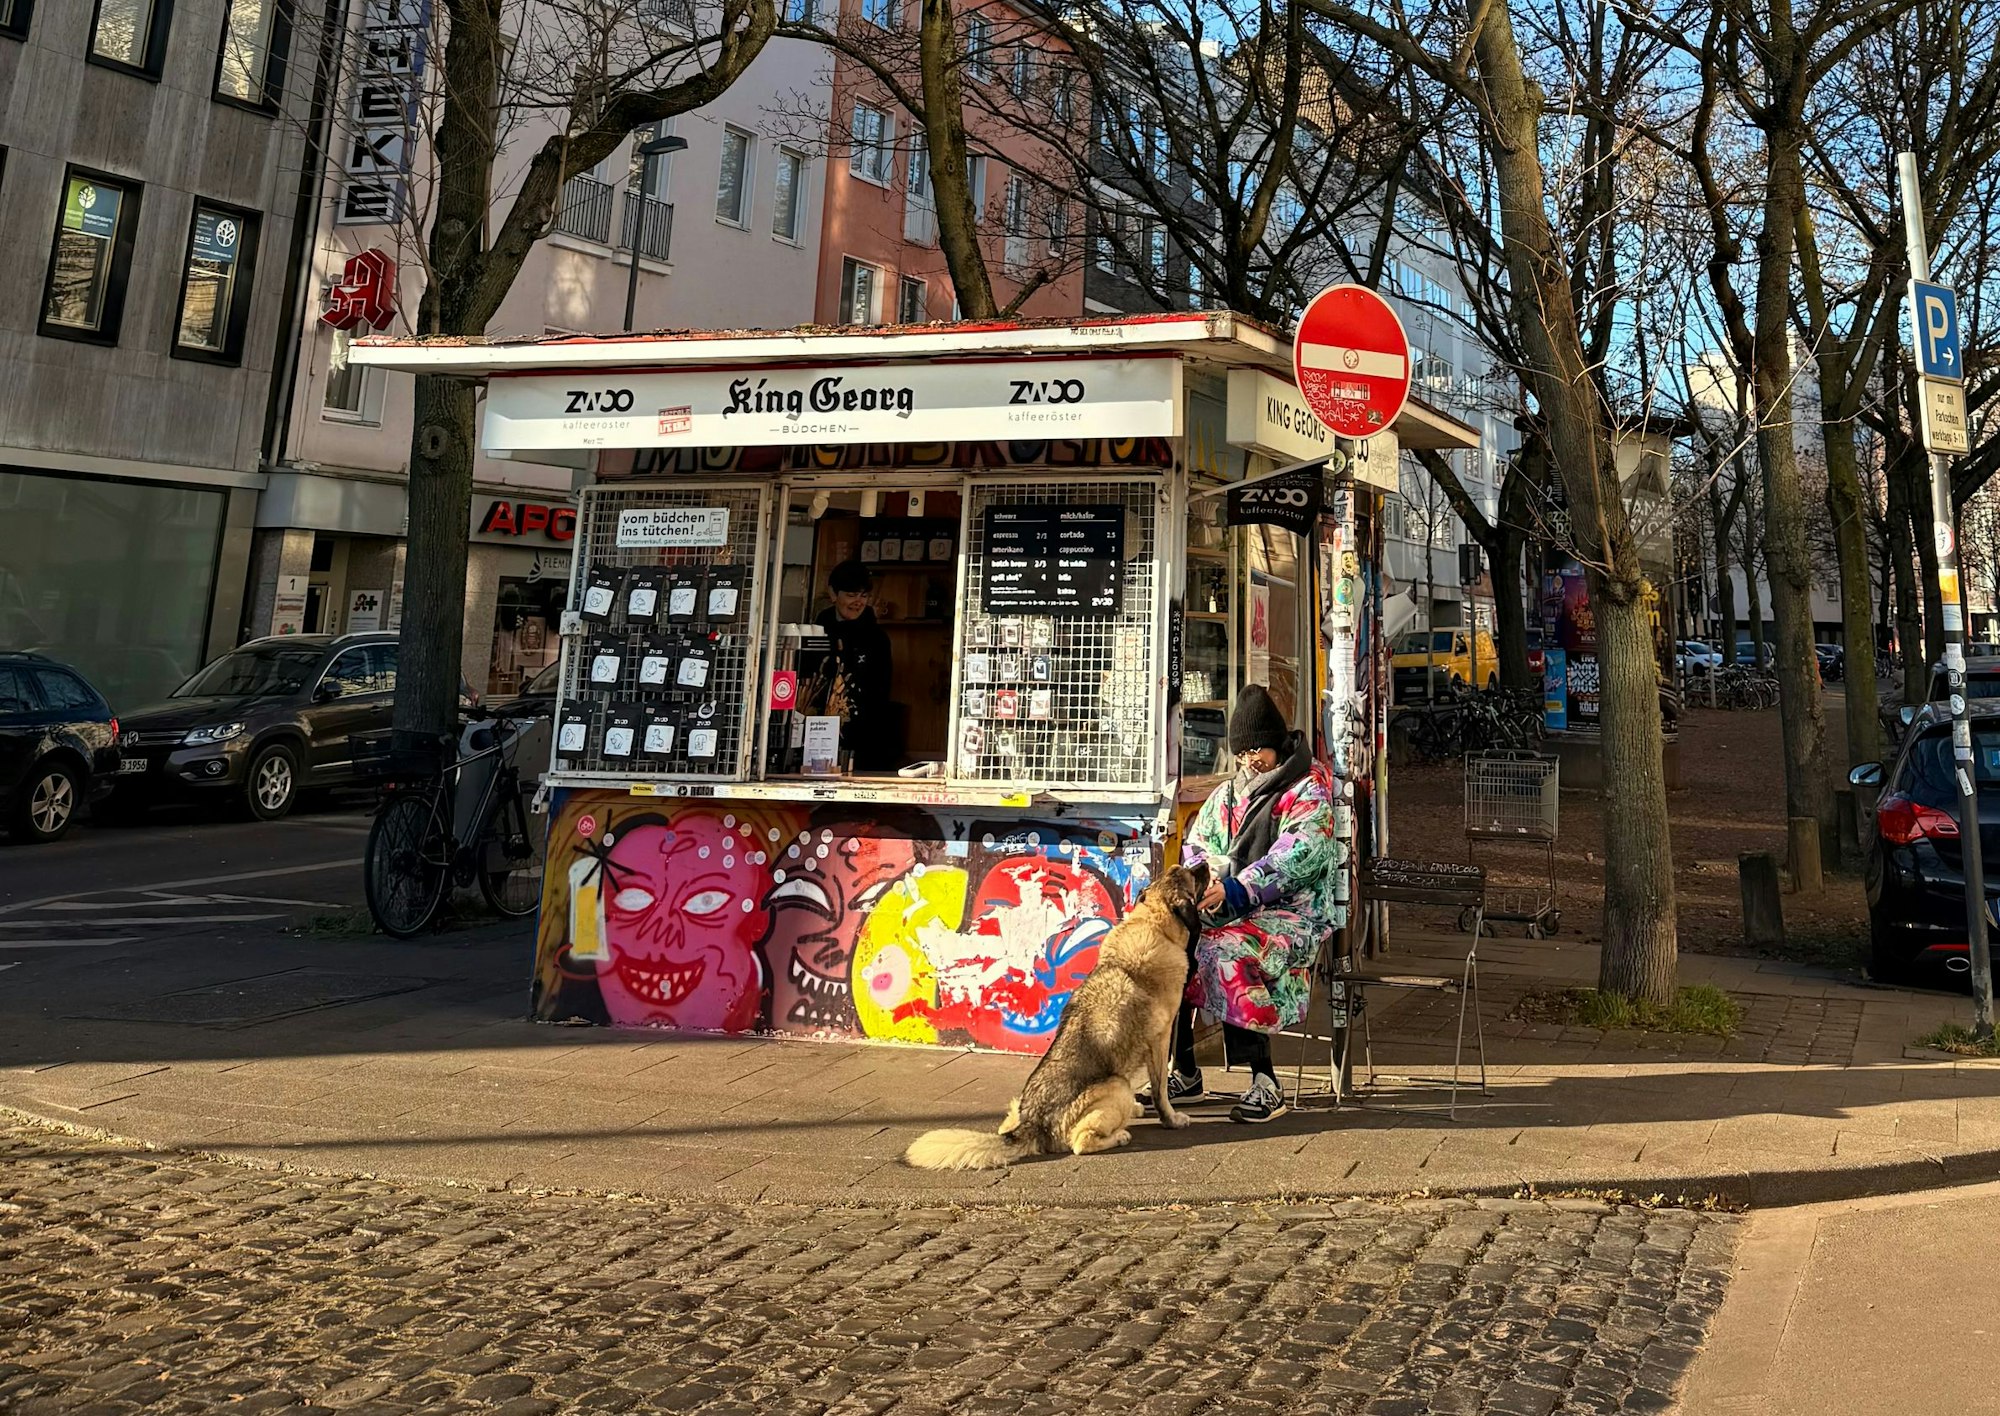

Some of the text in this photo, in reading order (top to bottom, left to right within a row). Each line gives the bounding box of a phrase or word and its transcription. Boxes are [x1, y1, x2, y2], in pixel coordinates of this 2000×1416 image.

[1924, 295, 1949, 364] P
[722, 376, 803, 421] King
[809, 376, 914, 420] Georg
[1267, 396, 1291, 430] KING
[782, 423, 847, 434] BÜDCHEN
[623, 511, 705, 524] vom büdchen
[621, 525, 694, 536] ins tütchen!
[1060, 531, 1085, 539] cortado
[1059, 545, 1095, 554] cappuccino
[289, 578, 296, 591] 1
[128, 760, 146, 770] 1956
